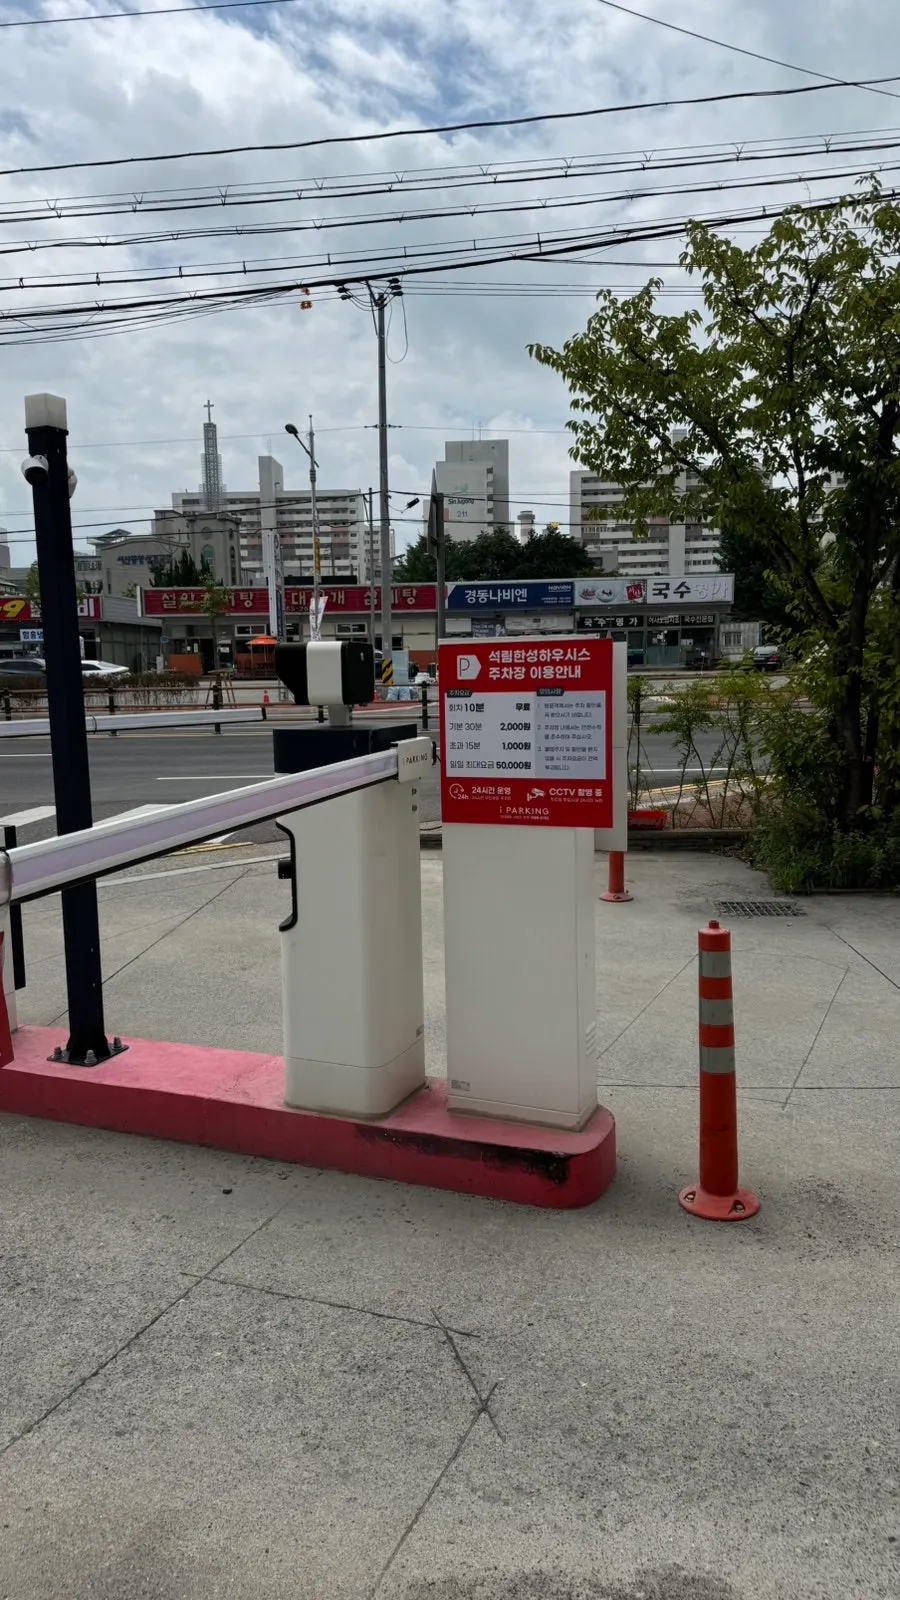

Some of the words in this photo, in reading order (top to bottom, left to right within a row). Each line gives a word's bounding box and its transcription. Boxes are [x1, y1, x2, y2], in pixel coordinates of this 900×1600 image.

[465, 588, 527, 604] 경동나비엔
[489, 647, 591, 664] 석림한성하우시스
[489, 667, 526, 681] 주차장
[530, 665, 582, 680] 이용안내
[449, 703, 463, 712] 회차
[464, 703, 484, 713] 10분
[515, 703, 531, 712] 무료
[449, 722, 463, 731] 기본
[465, 722, 482, 731] 30분
[500, 722, 531, 731] 2,000원
[449, 741, 464, 750] 초과
[465, 741, 481, 750] 15분
[502, 741, 531, 751] 1,000원
[449, 761, 464, 769] 일일
[466, 761, 495, 769] 최대요금
[496, 761, 532, 770] 50,000원
[472, 786, 496, 795] 24시간
[497, 786, 511, 795] 운영
[549, 787, 576, 796] CCTV
[577, 788, 593, 797] 촬영
[594, 788, 603, 797] 중
[505, 807, 550, 816] PARKING
